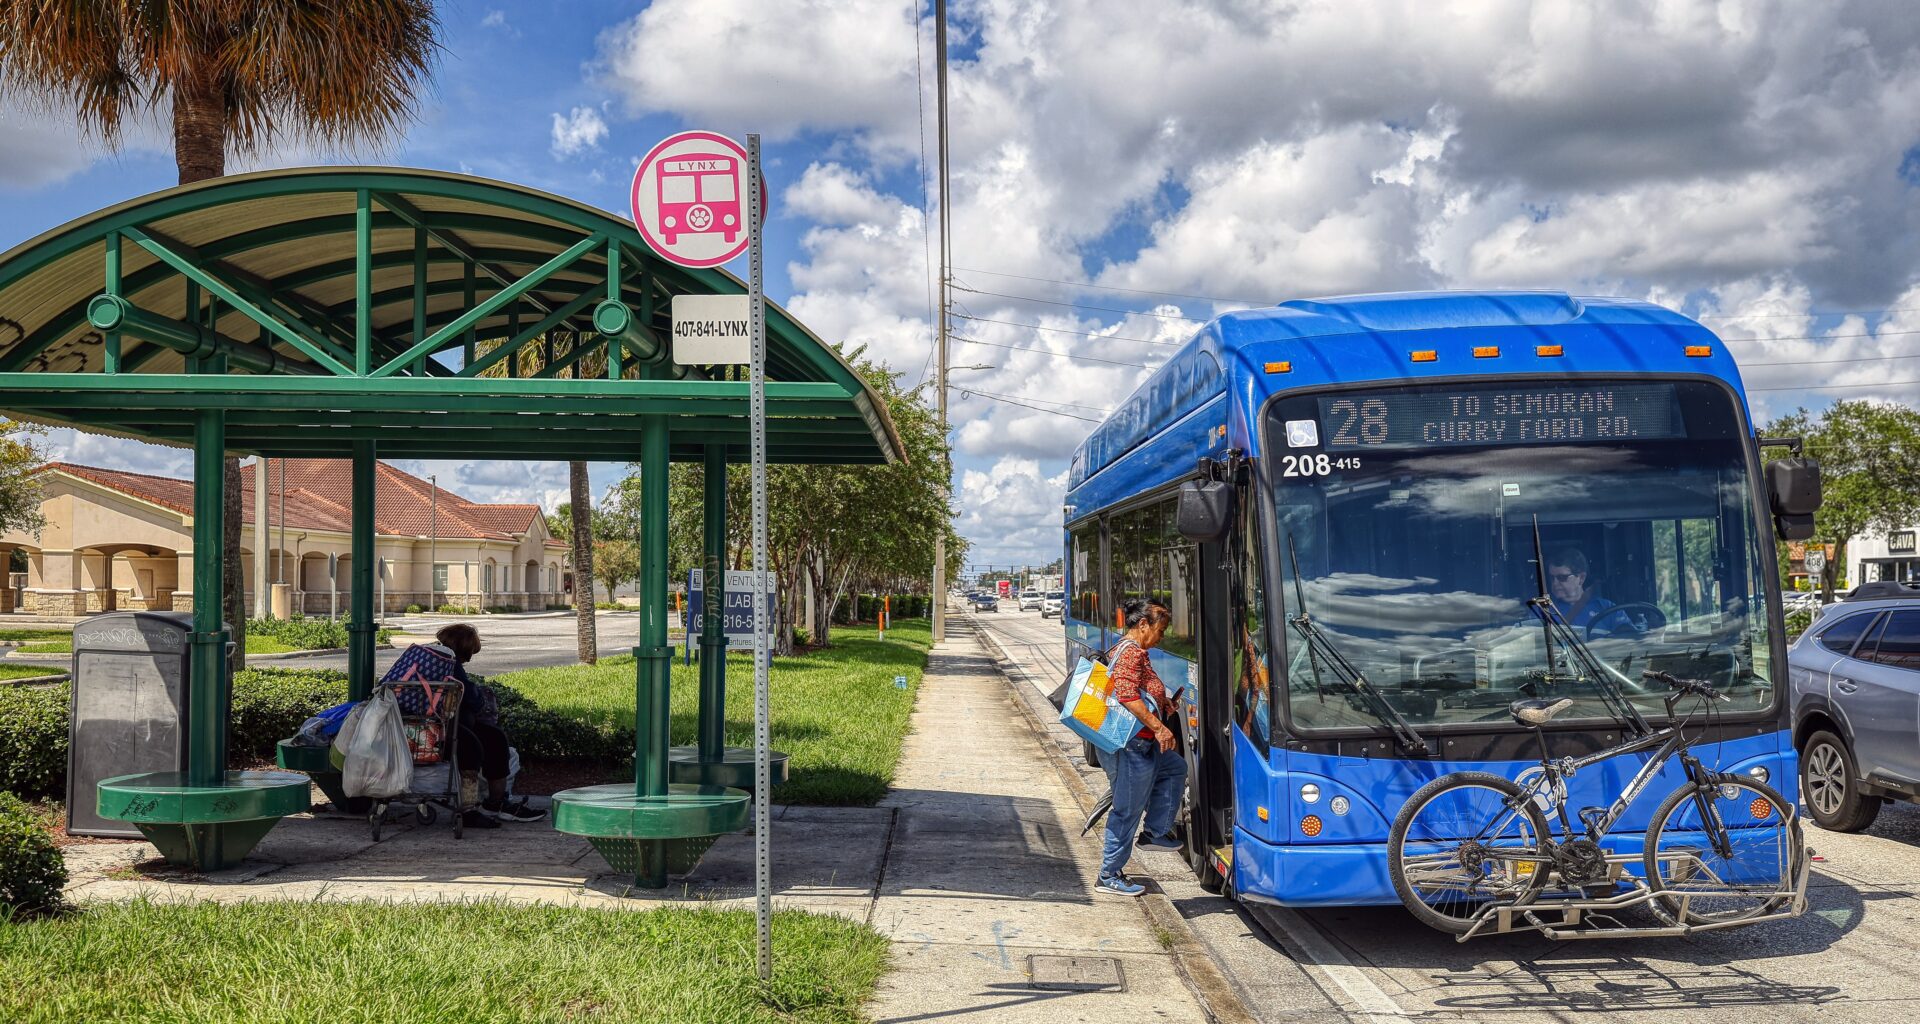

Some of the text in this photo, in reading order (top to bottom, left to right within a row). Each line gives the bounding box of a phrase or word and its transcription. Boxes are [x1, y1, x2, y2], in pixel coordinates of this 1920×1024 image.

[678, 161, 717, 171] LYNX
[674, 320, 749, 338] 407-841-LYNX
[1448, 391, 1614, 417] TO SEMORAN
[1330, 399, 1388, 446] 28
[1423, 415, 1639, 443] CURRY FORD RD.
[1281, 454, 1361, 478] 208-415
[1890, 534, 1914, 549] CAVA
[726, 575, 774, 588] VENTUS
